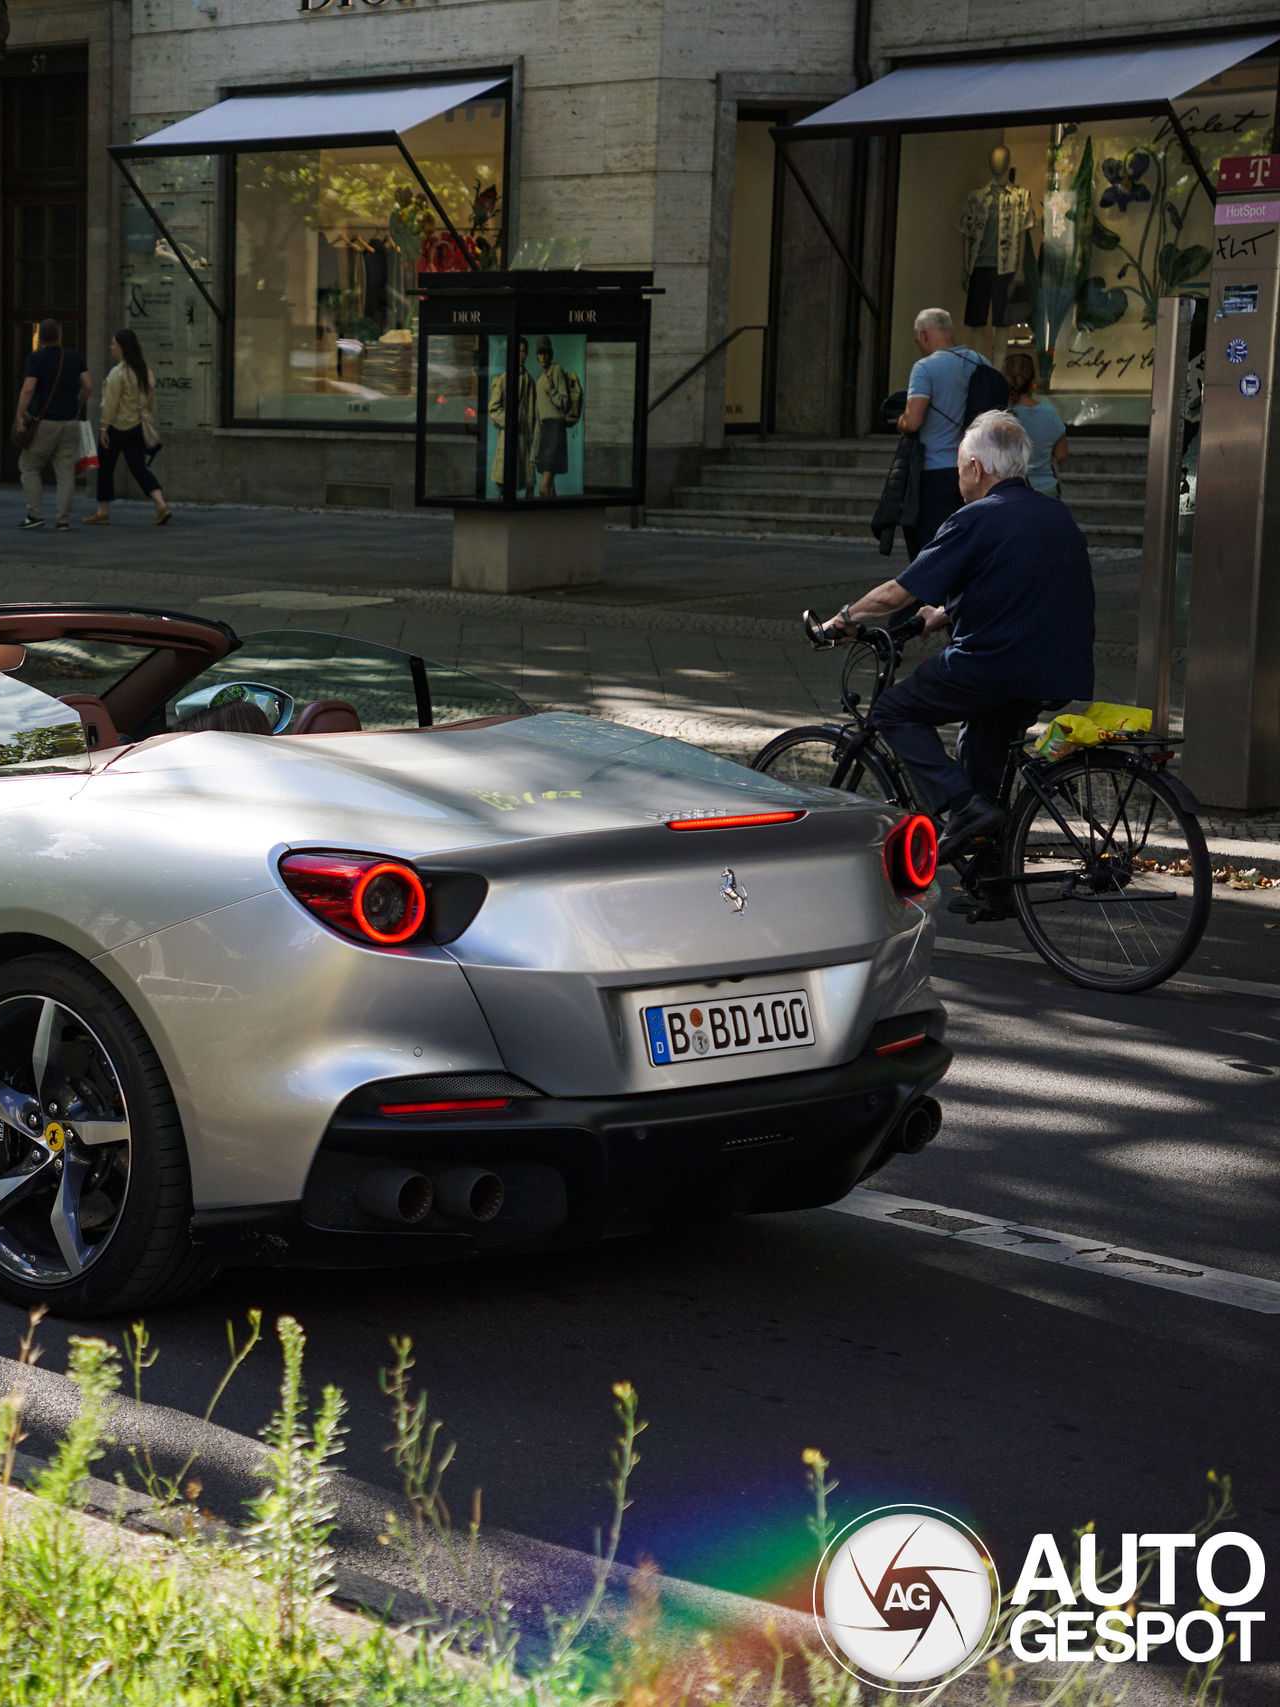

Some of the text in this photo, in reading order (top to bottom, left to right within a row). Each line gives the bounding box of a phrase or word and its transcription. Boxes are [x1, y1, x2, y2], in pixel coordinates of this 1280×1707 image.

[1226, 205, 1266, 218] HotSpot
[453, 310, 482, 323] DIOR
[569, 310, 598, 323] DIOR
[1066, 346, 1112, 379] Lily
[668, 998, 809, 1055] B BD 100
[656, 1041, 665, 1054] D
